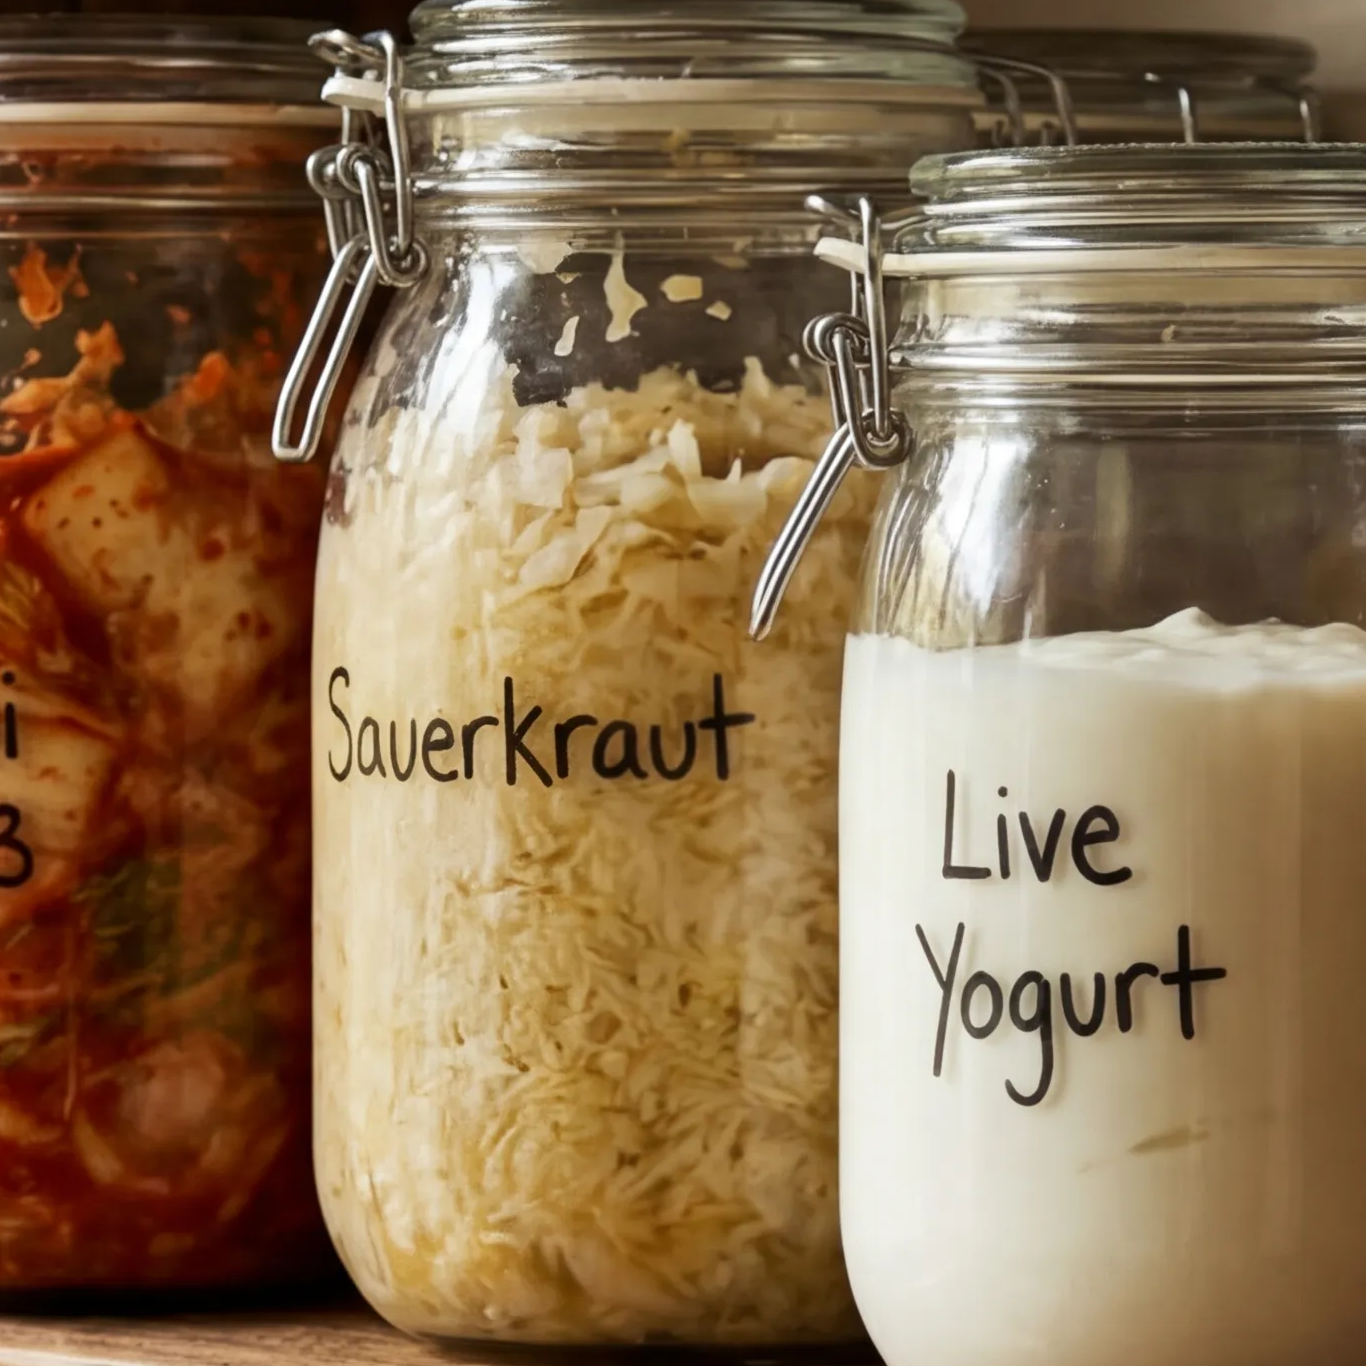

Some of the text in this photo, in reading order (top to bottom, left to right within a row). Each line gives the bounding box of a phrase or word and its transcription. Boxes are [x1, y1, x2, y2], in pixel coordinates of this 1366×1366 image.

[326, 665, 756, 788] Sauerkraut
[941, 769, 1132, 886] Live
[915, 922, 1227, 1107] Yogurt
